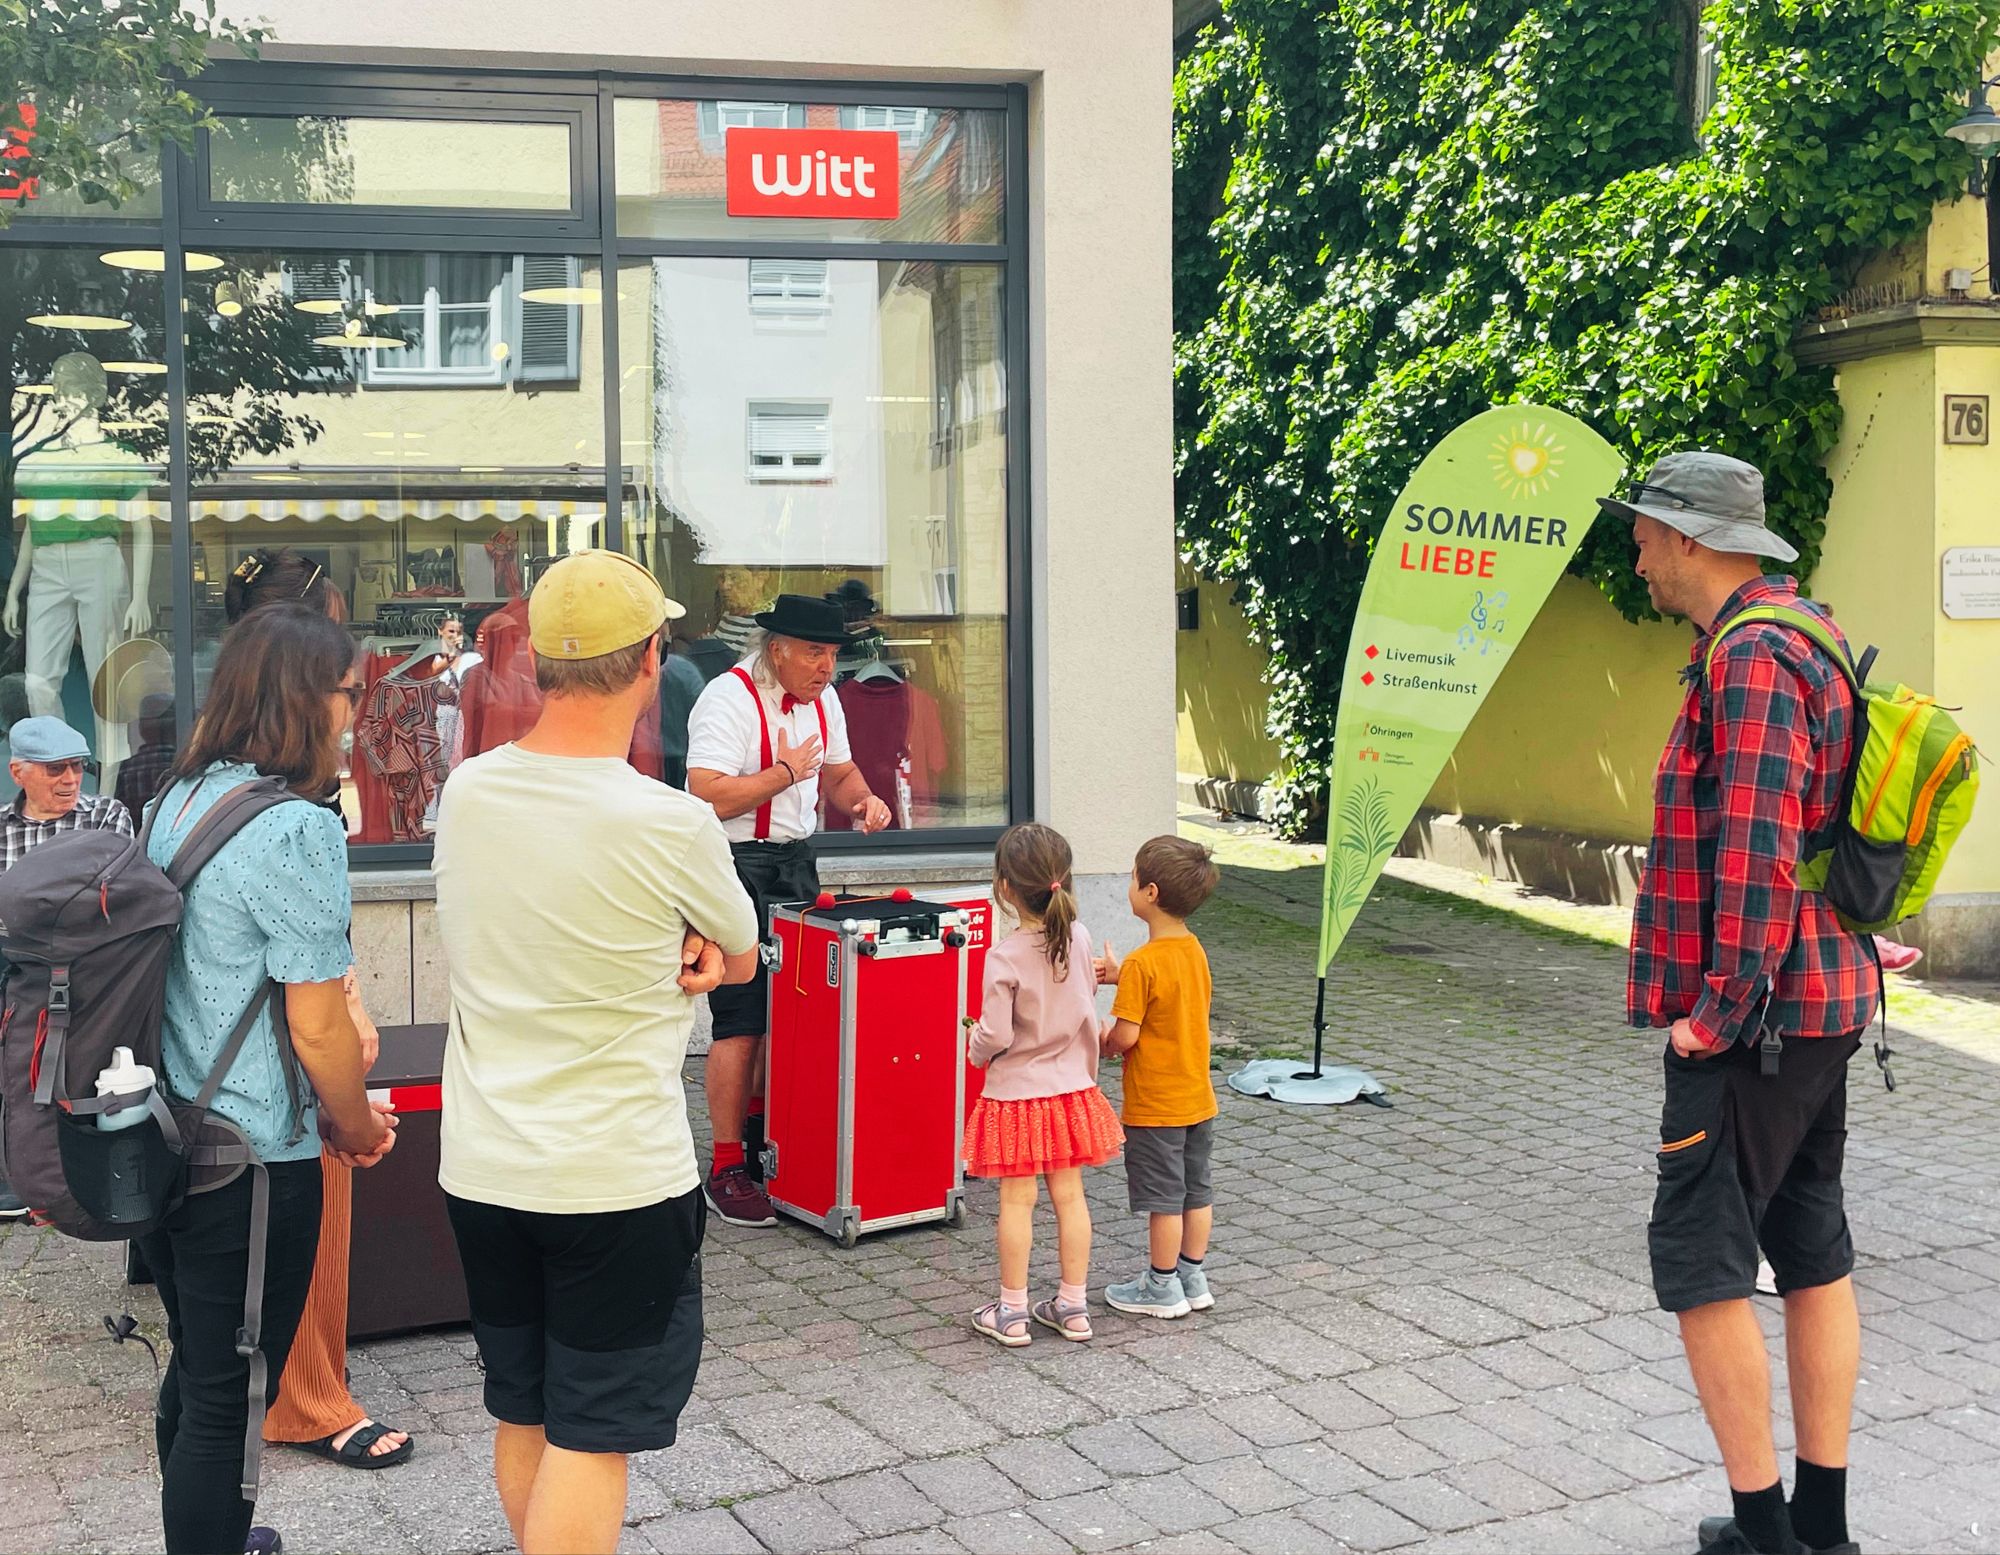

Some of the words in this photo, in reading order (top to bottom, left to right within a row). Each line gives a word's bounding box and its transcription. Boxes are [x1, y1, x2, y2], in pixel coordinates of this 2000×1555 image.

[751, 149, 876, 198] Witt
[1951, 403, 1983, 436] 76
[1404, 504, 1567, 547] SOMMER
[1400, 542, 1497, 578] LIEBE
[1386, 648, 1456, 666] Livemusik
[1382, 673, 1478, 694] Straßenkunst
[1370, 725, 1413, 739] Öhringen
